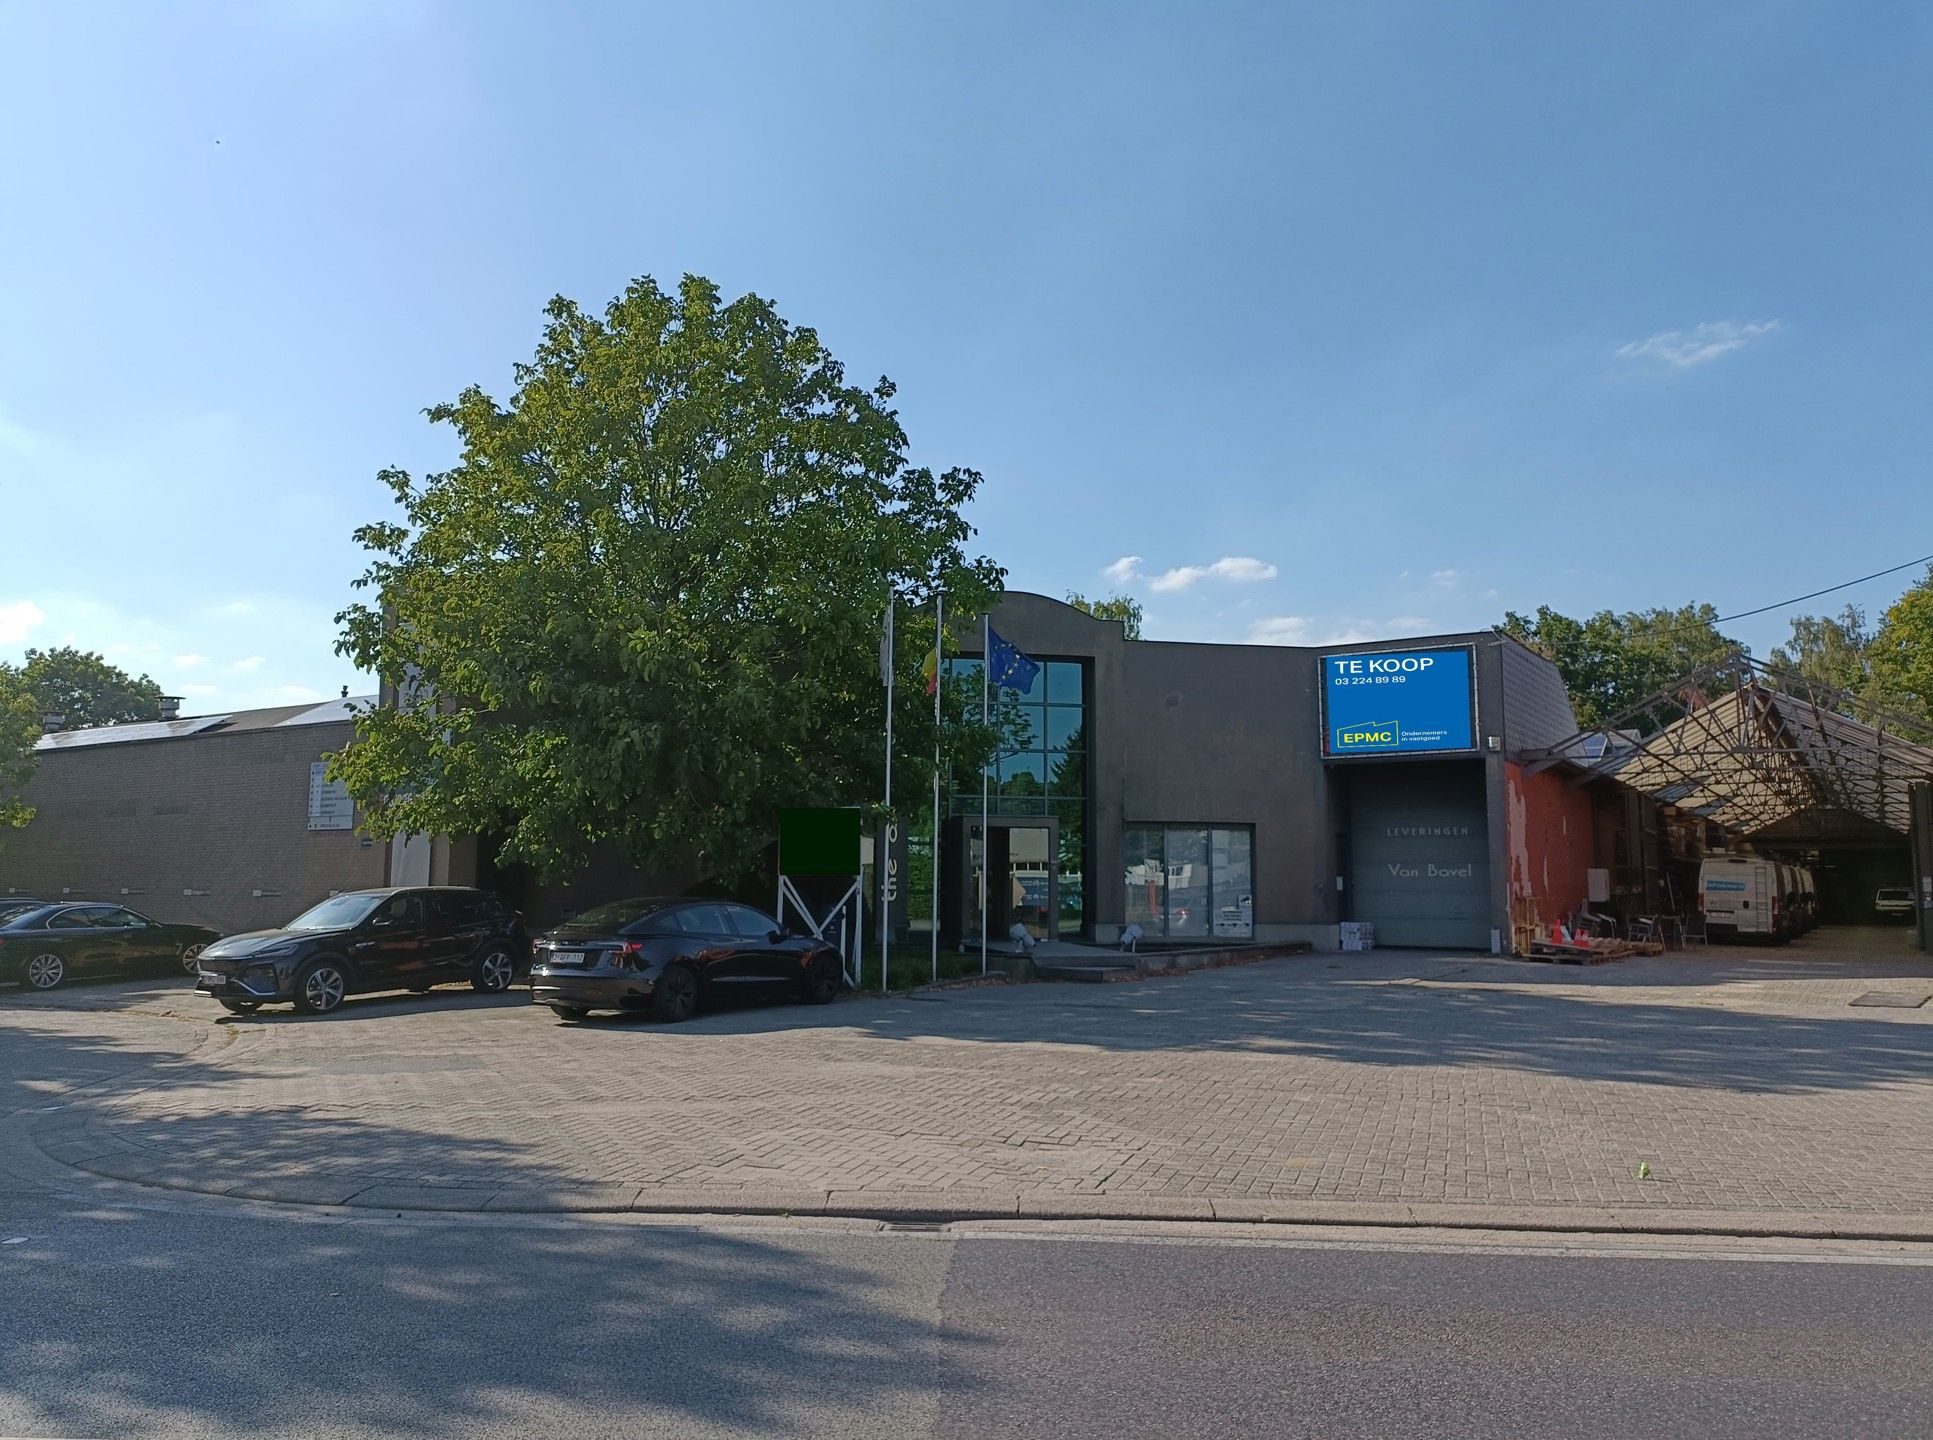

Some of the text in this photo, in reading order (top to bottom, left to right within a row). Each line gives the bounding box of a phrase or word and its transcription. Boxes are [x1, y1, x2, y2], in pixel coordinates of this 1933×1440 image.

[1334, 658, 1434, 674] TE KOOP
[1335, 675, 1406, 685] 03 224 89 89
[1343, 731, 1392, 743] EPMC
[1387, 827, 1468, 836] LEVERINGEN
[1388, 863, 1418, 877] Van
